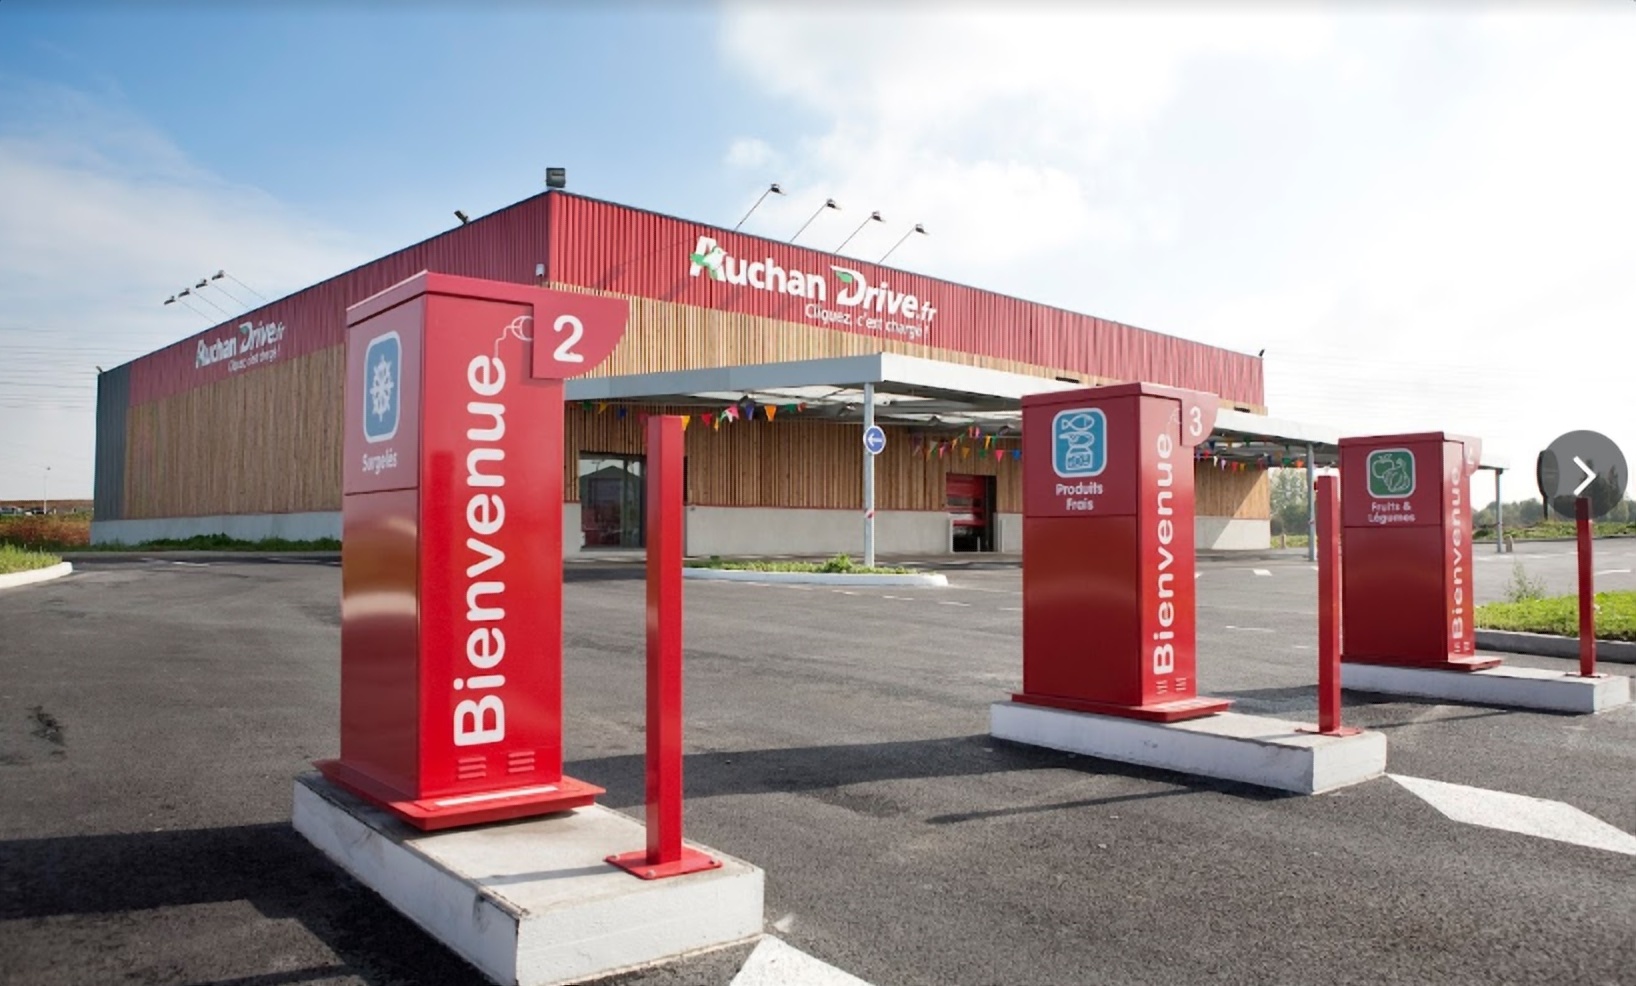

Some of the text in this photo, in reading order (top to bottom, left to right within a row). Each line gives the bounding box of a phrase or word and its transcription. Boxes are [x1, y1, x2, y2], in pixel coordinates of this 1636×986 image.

[690, 236, 937, 321] Auchan Drive.fr
[195, 337, 237, 369] Auchan
[553, 315, 584, 363] 2
[1189, 406, 1203, 436] 3
[362, 448, 398, 475] Surgelés
[1056, 481, 1103, 496] Produits
[1066, 498, 1094, 511] Frais
[1368, 512, 1416, 525] Légumes
[1371, 501, 1412, 512] Fruits &
[453, 354, 507, 747] Bienvenue
[1153, 433, 1174, 675] Bienvenue
[1451, 466, 1464, 639] Bienvenue
